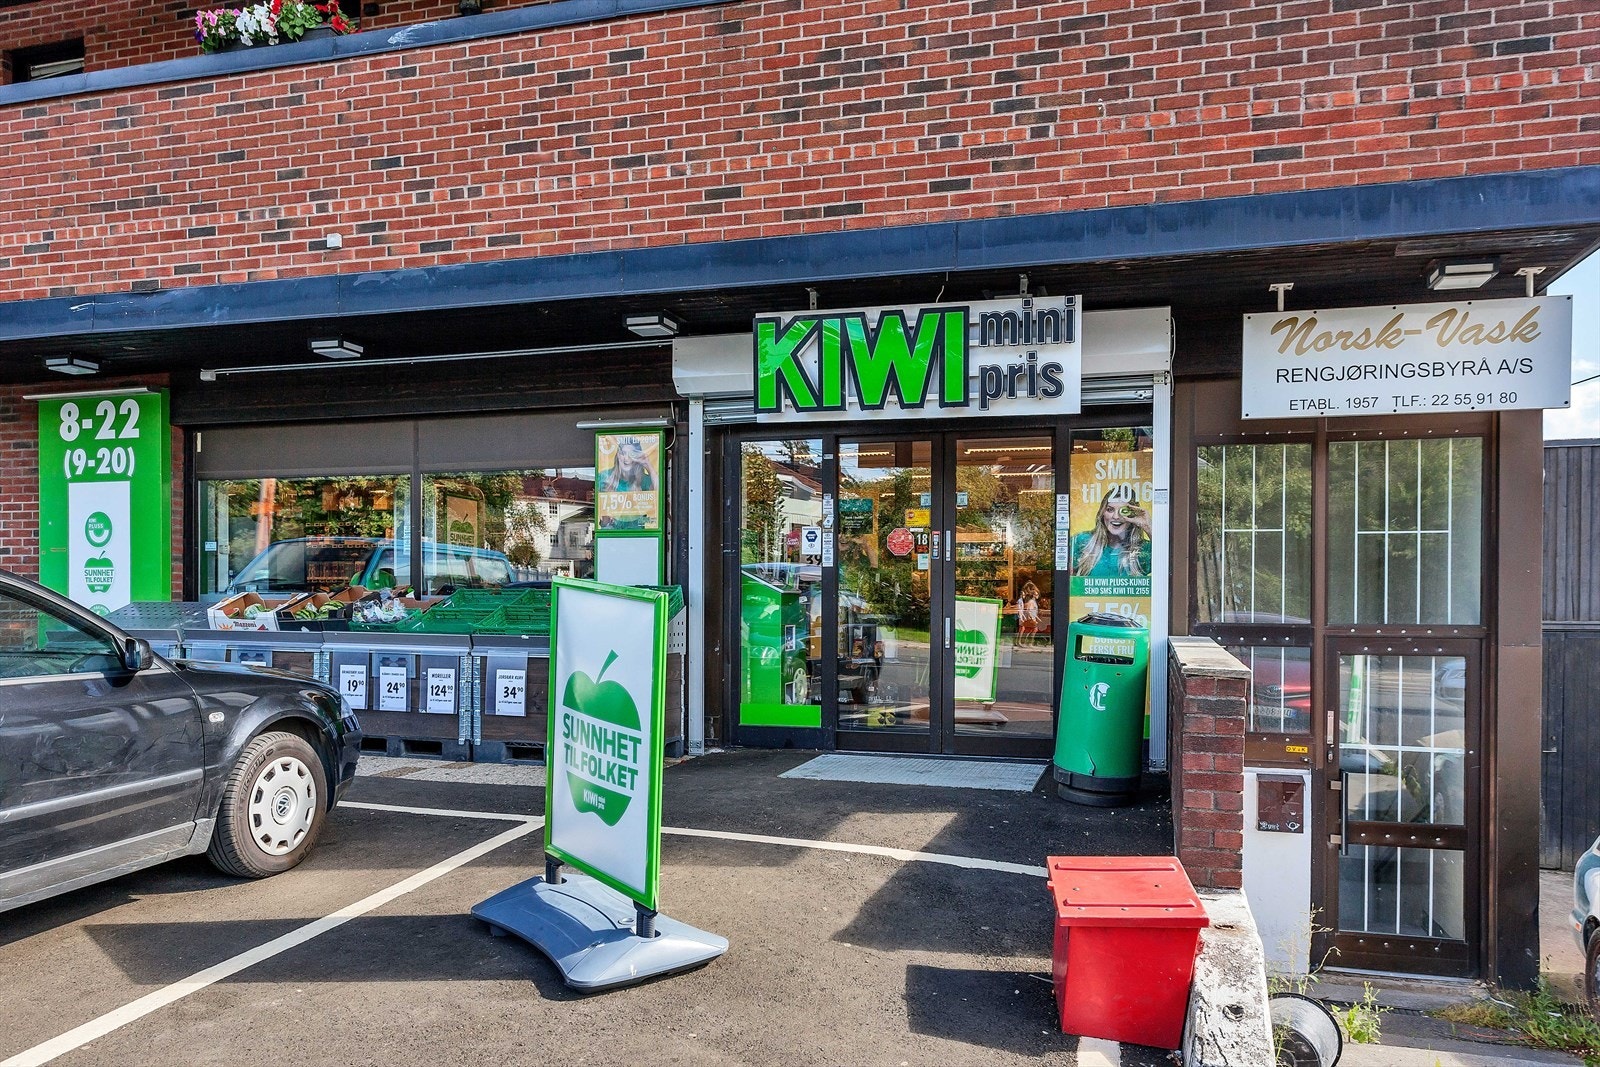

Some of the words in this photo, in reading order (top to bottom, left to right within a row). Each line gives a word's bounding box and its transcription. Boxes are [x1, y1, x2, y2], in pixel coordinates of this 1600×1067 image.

[979, 295, 1076, 347] mini
[1271, 305, 1541, 356] Norsk-Vask
[754, 306, 969, 413] KIWI
[1276, 357, 1492, 383] RENGJØRINGSBYRÅ
[1496, 357, 1534, 375] A/S
[979, 351, 1064, 411] pris
[1289, 399, 1340, 411] ETABL.
[1345, 397, 1379, 409] 1957
[1392, 395, 1427, 407] TLF.:
[1431, 394, 1449, 406] 22
[1454, 393, 1472, 405] 55
[1476, 392, 1493, 405] 91
[1499, 392, 1518, 404] 80
[59, 399, 140, 442] 8-22
[64, 446, 136, 478] (9-20)
[1095, 459, 1140, 480] SMIL
[600, 493, 632, 512] 7,5%
[632, 494, 654, 502] BONUS
[1082, 483, 1102, 504] til
[1108, 482, 1152, 503] 2016
[916, 534, 928, 545] 18
[1084, 578, 1094, 586] BLI
[1095, 578, 1109, 586] KIWI
[1110, 578, 1150, 586] PLUSS-KUNDE
[1117, 646, 1134, 655] FRU
[563, 712, 642, 765] SUNNHET
[564, 742, 580, 771] TIL
[581, 752, 638, 791] FOLKET
[584, 788, 598, 807] KIWI
